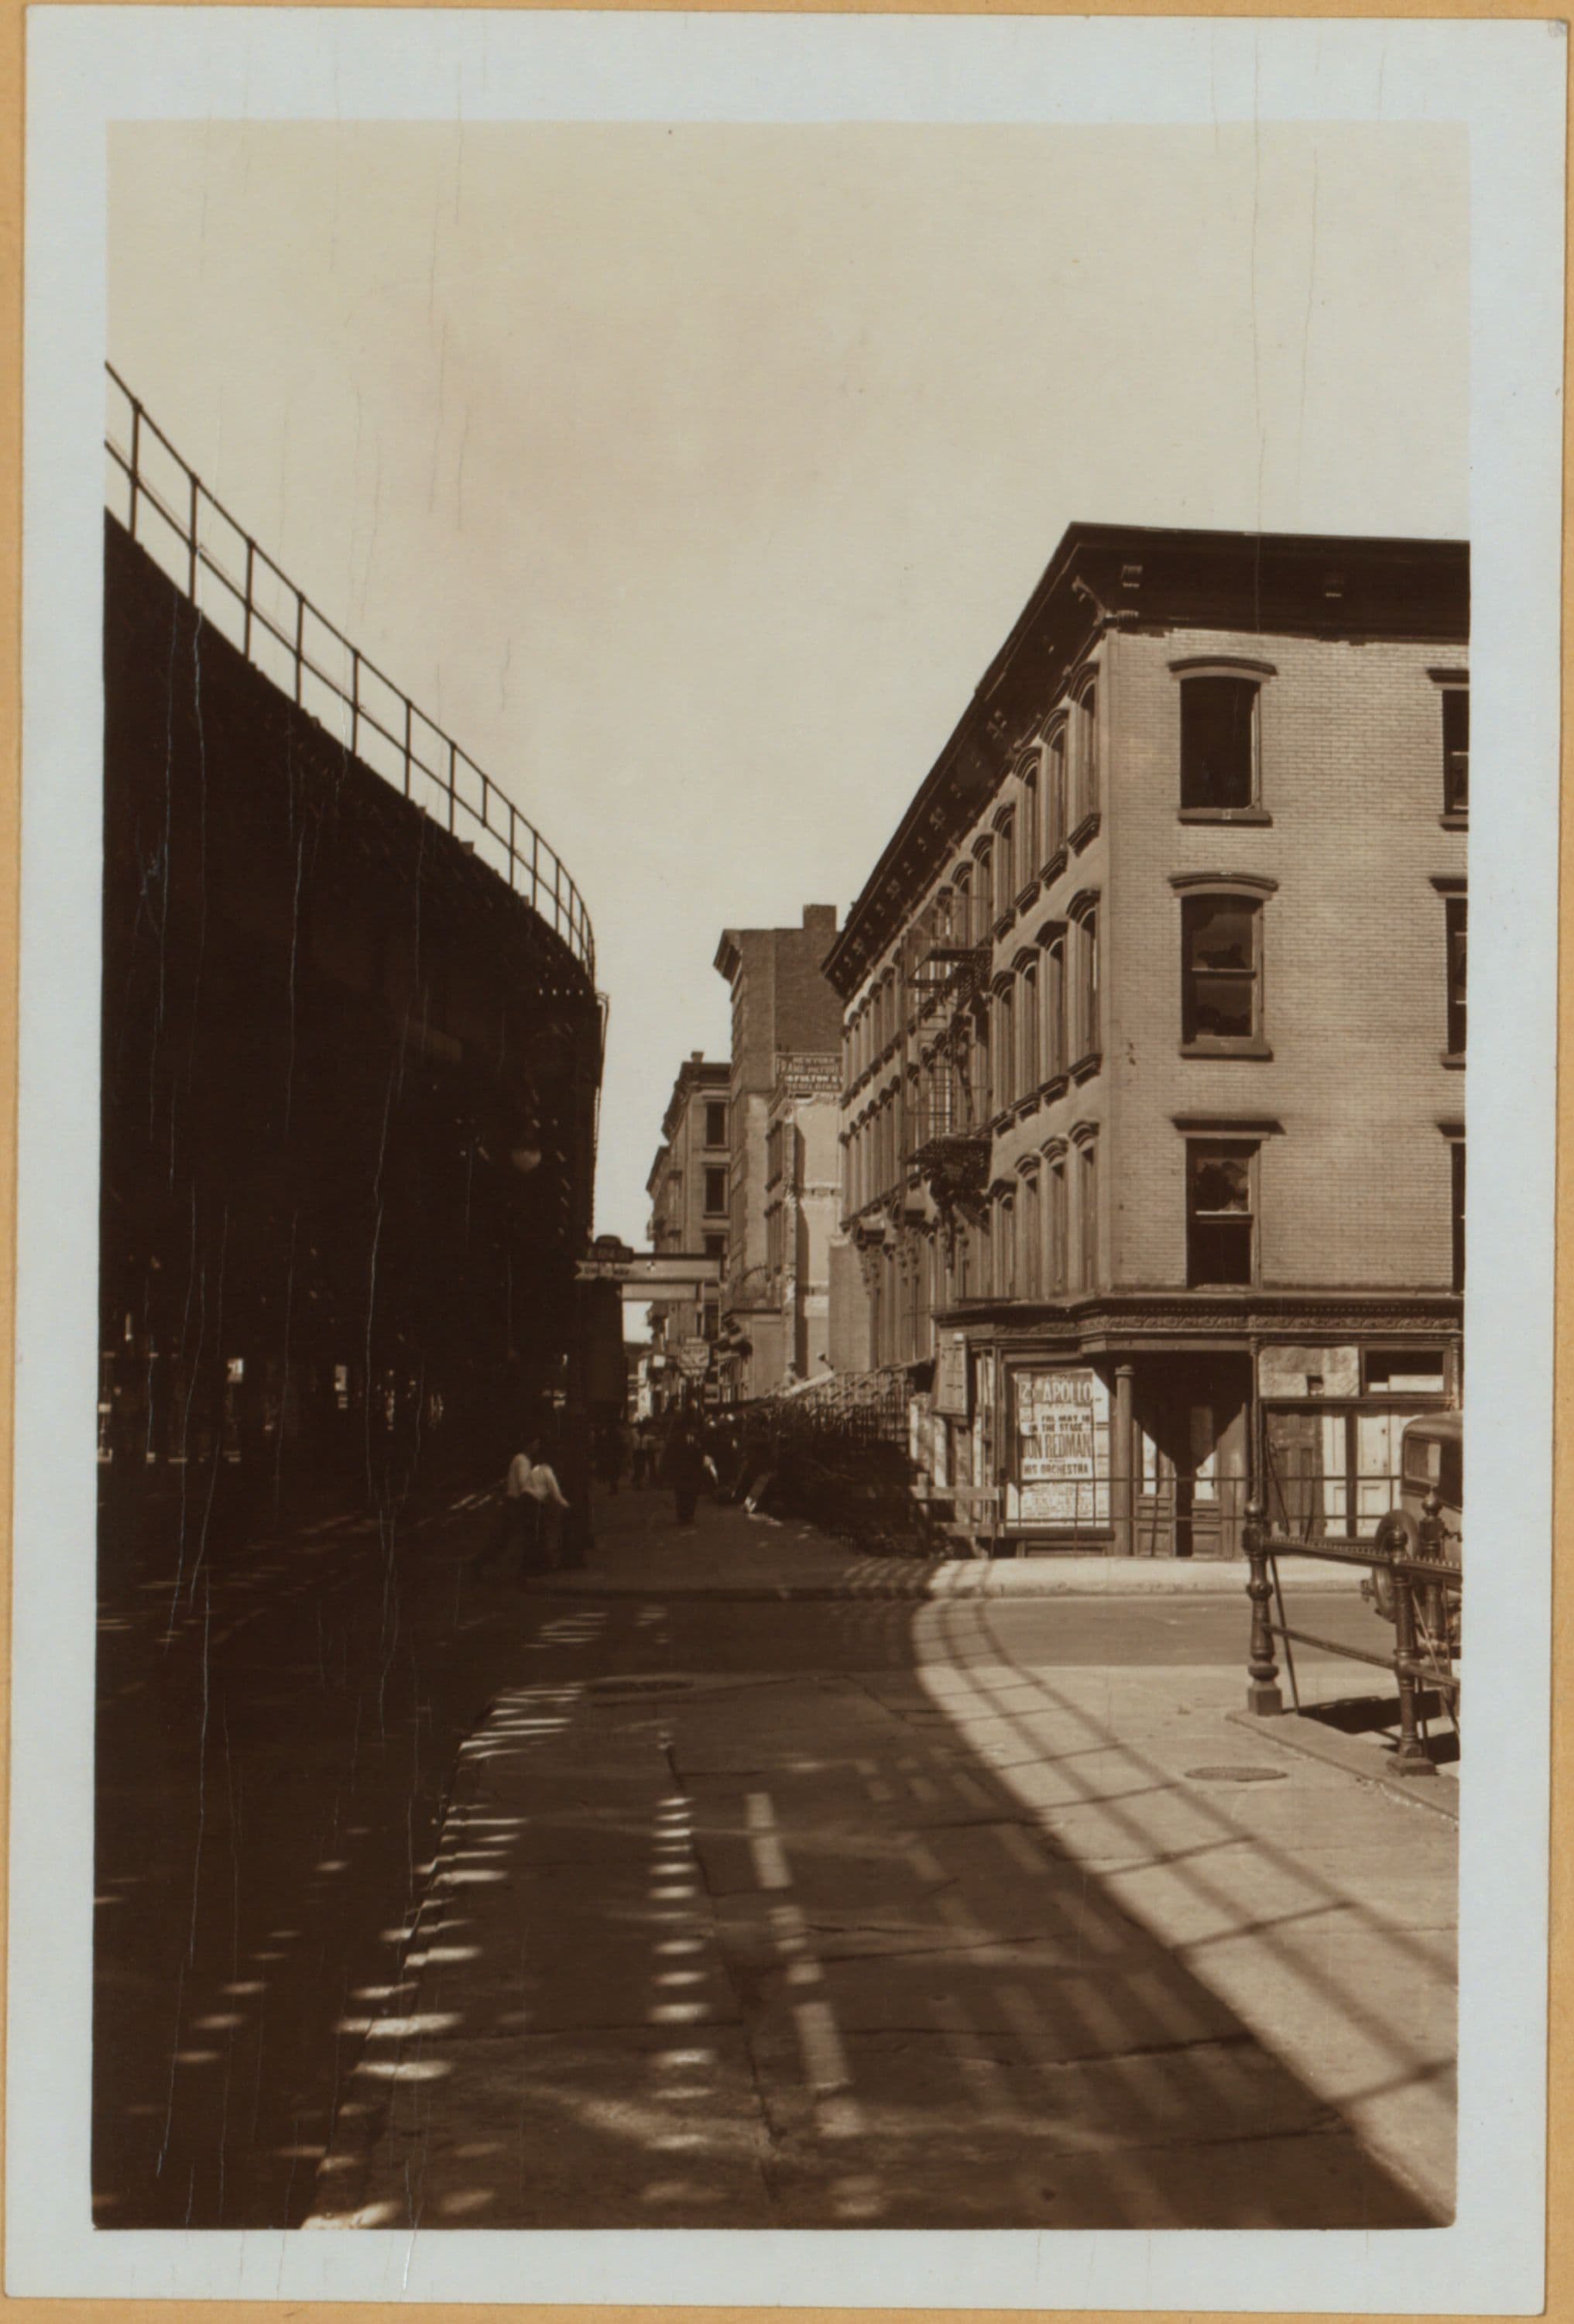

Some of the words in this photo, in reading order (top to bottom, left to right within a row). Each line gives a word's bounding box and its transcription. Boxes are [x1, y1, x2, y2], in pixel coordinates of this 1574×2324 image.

[1043, 1382, 1092, 1402] APOLLO
[1042, 1423, 1054, 1432] THE
[1059, 1423, 1082, 1432] STAGE
[1044, 1433, 1092, 1458] REDMAN
[1024, 1464, 1037, 1474] HIS
[1041, 1463, 1089, 1474] ORCHESTRA
